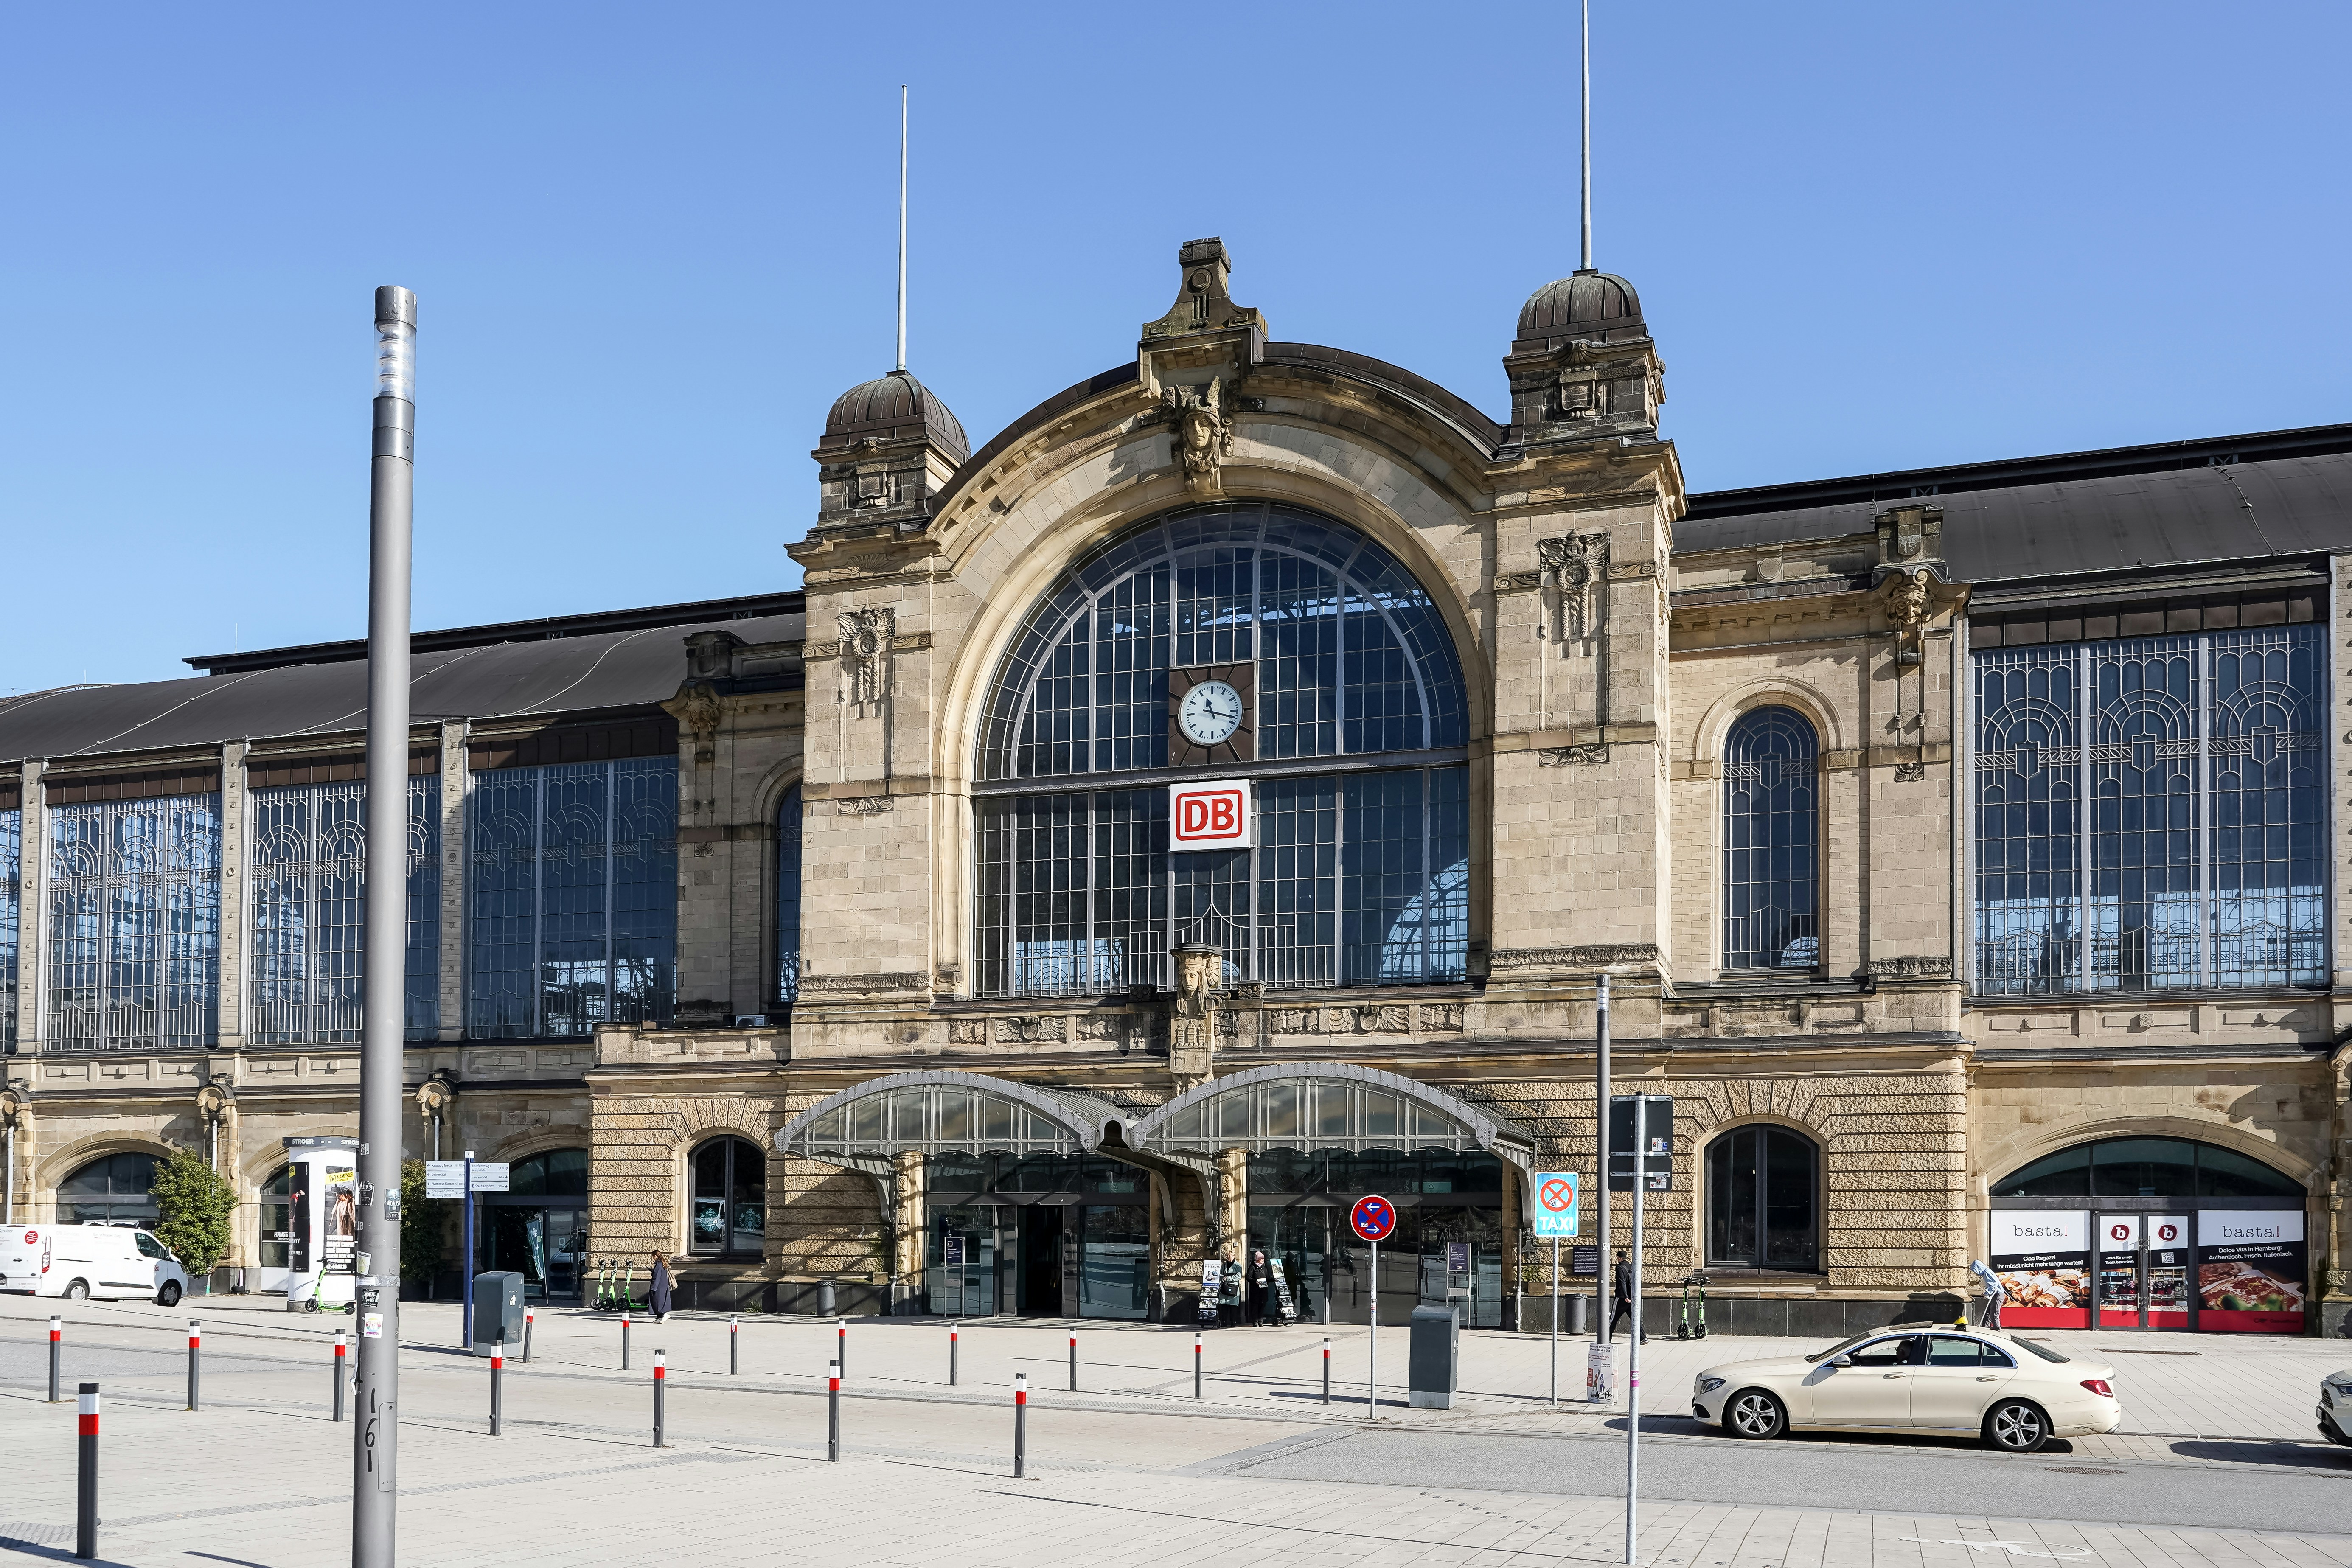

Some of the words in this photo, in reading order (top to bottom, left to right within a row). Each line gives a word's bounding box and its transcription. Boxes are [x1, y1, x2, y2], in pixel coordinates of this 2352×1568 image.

[1185, 798, 1234, 832] DB
[1539, 1217, 1574, 1231] TAXI
[2013, 1225, 2067, 1237] basta!
[2222, 1225, 2279, 1237] basta!
